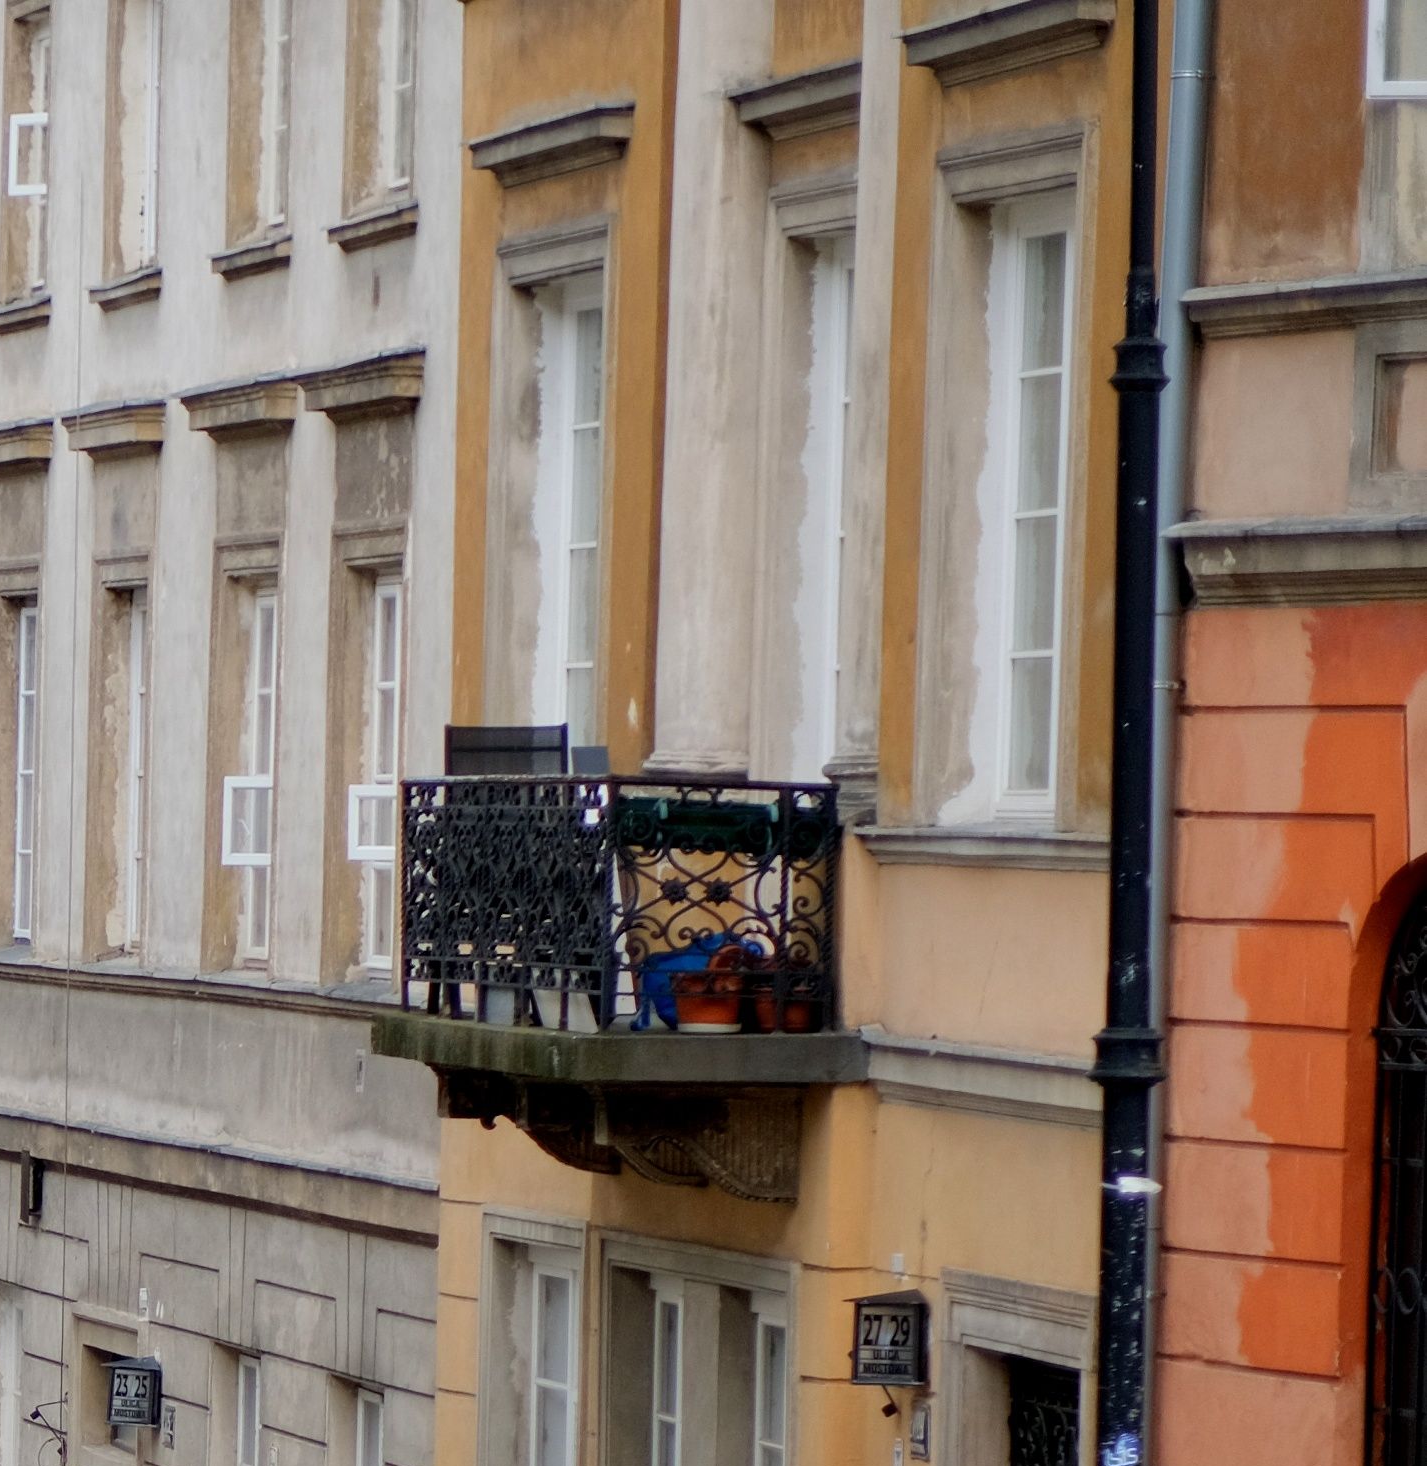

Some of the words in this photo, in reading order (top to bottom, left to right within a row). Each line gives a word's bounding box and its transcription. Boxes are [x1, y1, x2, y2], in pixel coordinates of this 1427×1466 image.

[863, 1314, 883, 1346] 27
[890, 1315, 910, 1347] 29
[873, 1349, 900, 1361] ULICA
[115, 1374, 129, 1397] 23
[134, 1375, 148, 1398] 25
